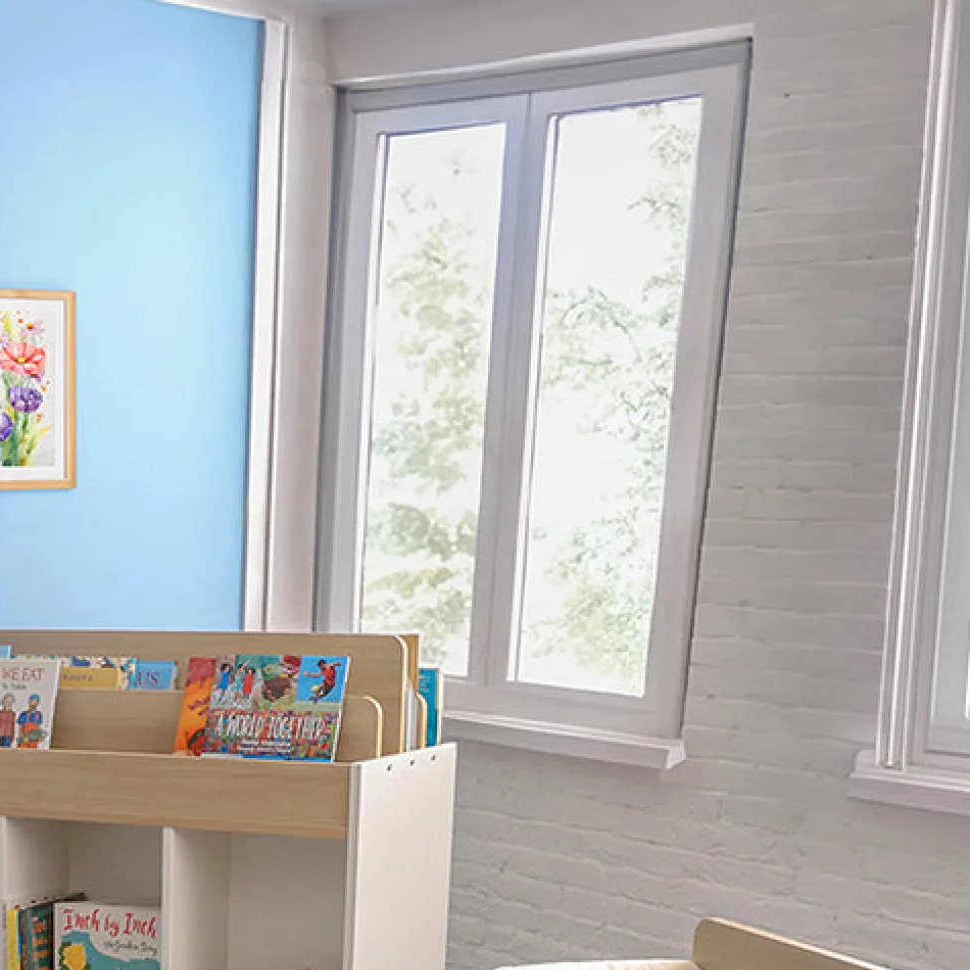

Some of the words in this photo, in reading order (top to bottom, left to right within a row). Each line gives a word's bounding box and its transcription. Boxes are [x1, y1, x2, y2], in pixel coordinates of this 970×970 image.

[1, 666, 20, 681] WE
[22, 667, 45, 681] EAT
[63, 908, 100, 932] Inch
[103, 913, 119, 938] by
[123, 912, 156, 940] Inch
